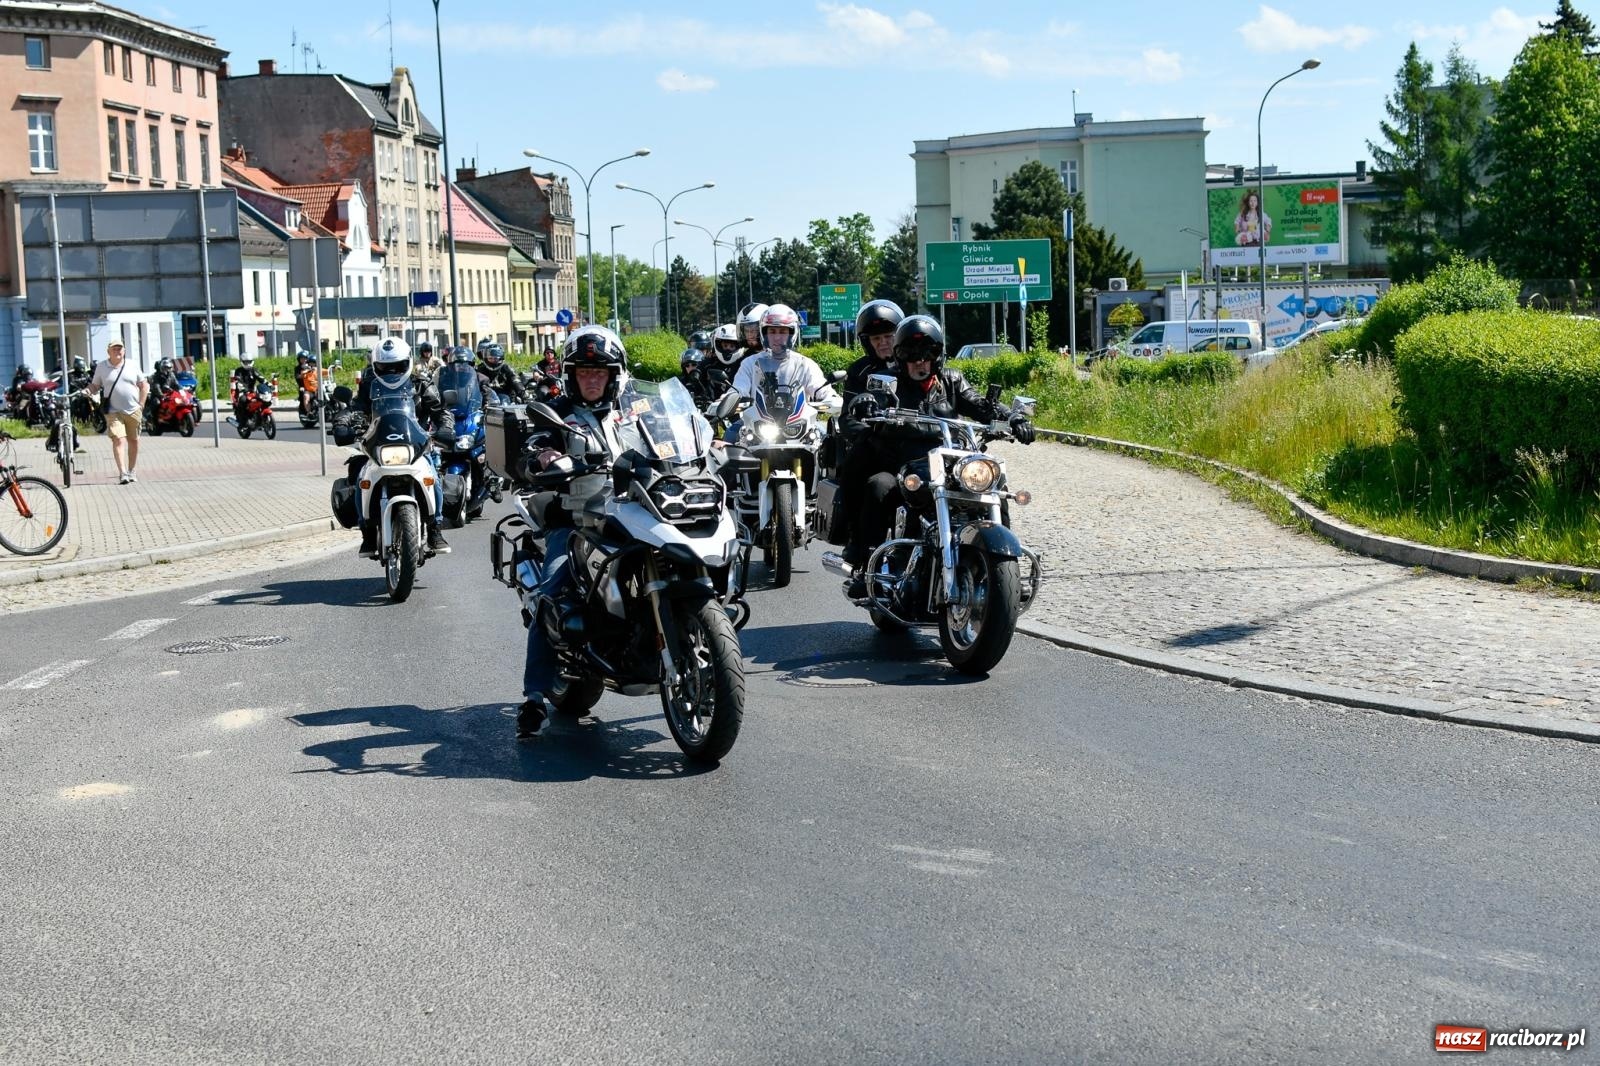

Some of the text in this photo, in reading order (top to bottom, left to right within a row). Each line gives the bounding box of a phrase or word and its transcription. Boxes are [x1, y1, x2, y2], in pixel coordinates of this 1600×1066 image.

[962, 244, 991, 254] Rybnik
[962, 255, 994, 263] Gliwice
[988, 265, 1012, 274] Miejski
[966, 275, 1038, 284] Starostwo Powiowe
[945, 291, 990, 299] 45 Opole
